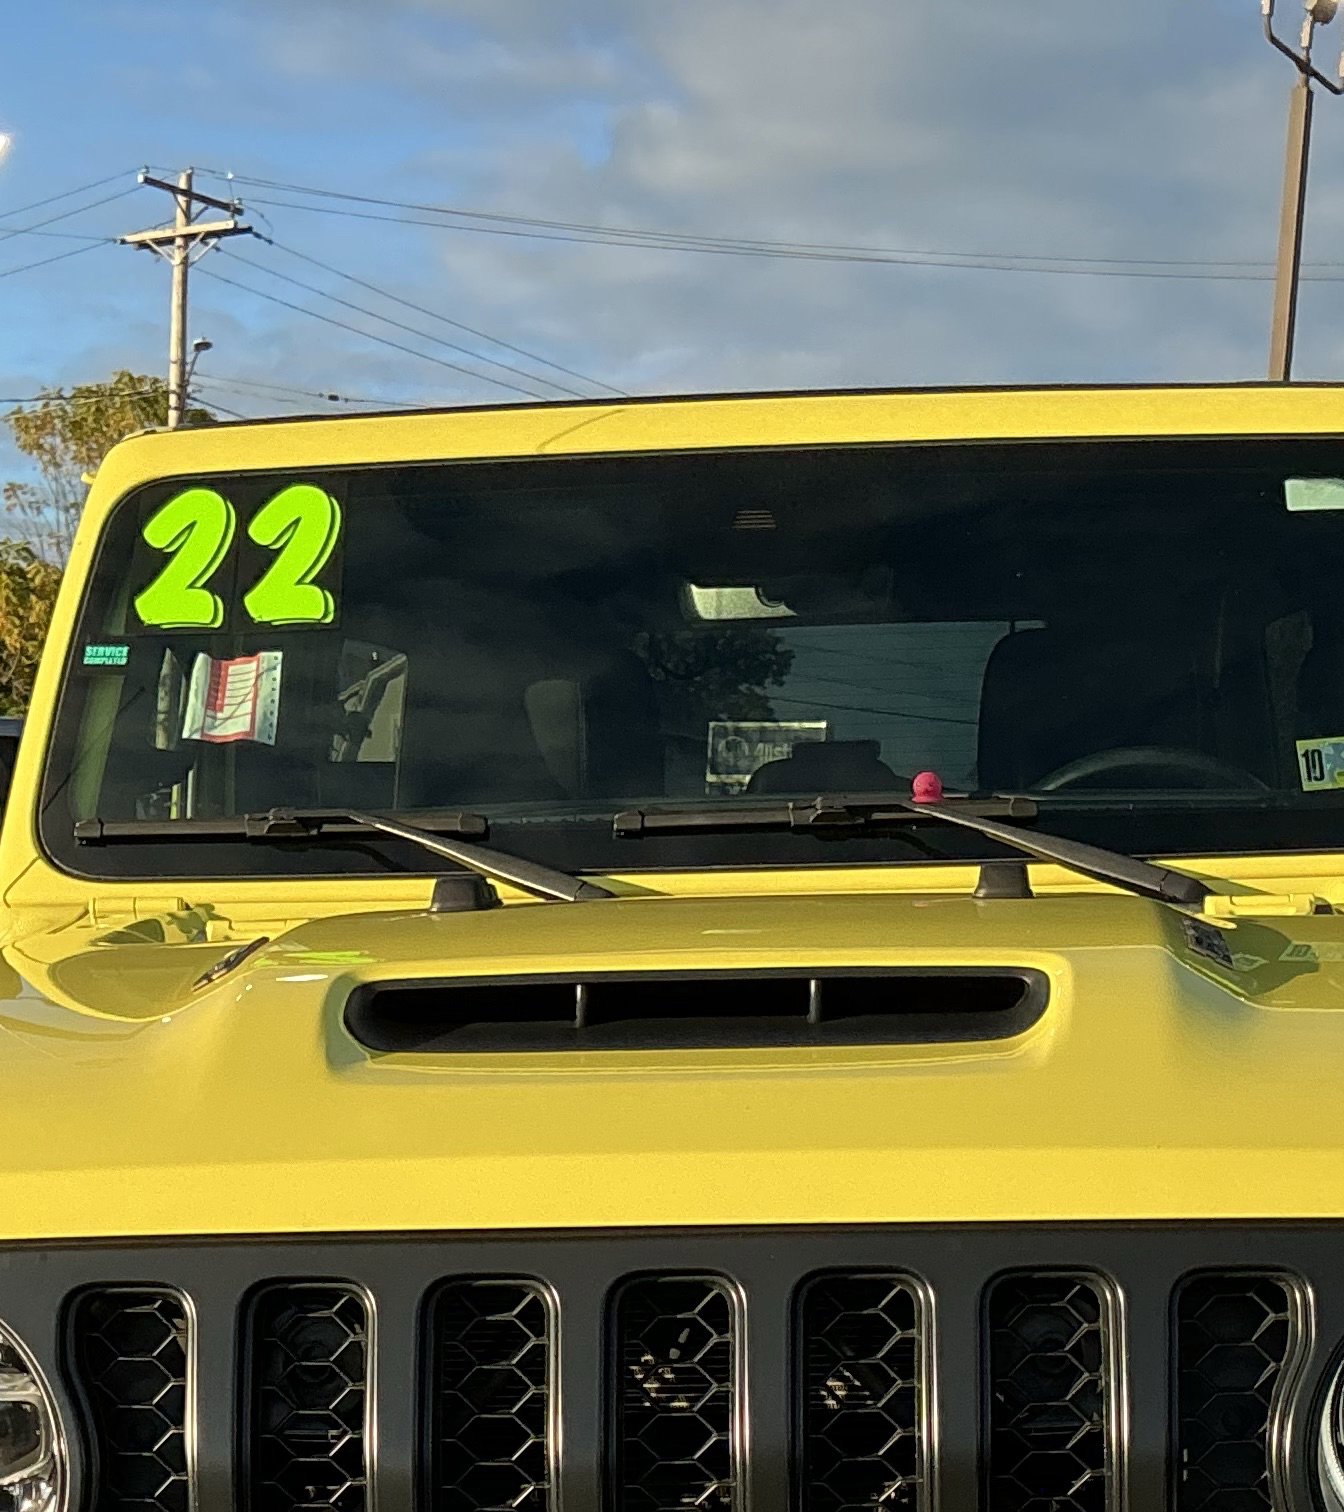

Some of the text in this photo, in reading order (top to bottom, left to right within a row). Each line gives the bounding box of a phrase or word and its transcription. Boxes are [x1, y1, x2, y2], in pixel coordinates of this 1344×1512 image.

[134, 484, 342, 629] 22
[84, 645, 130, 657] SERVICE
[1302, 748, 1326, 783] 10
